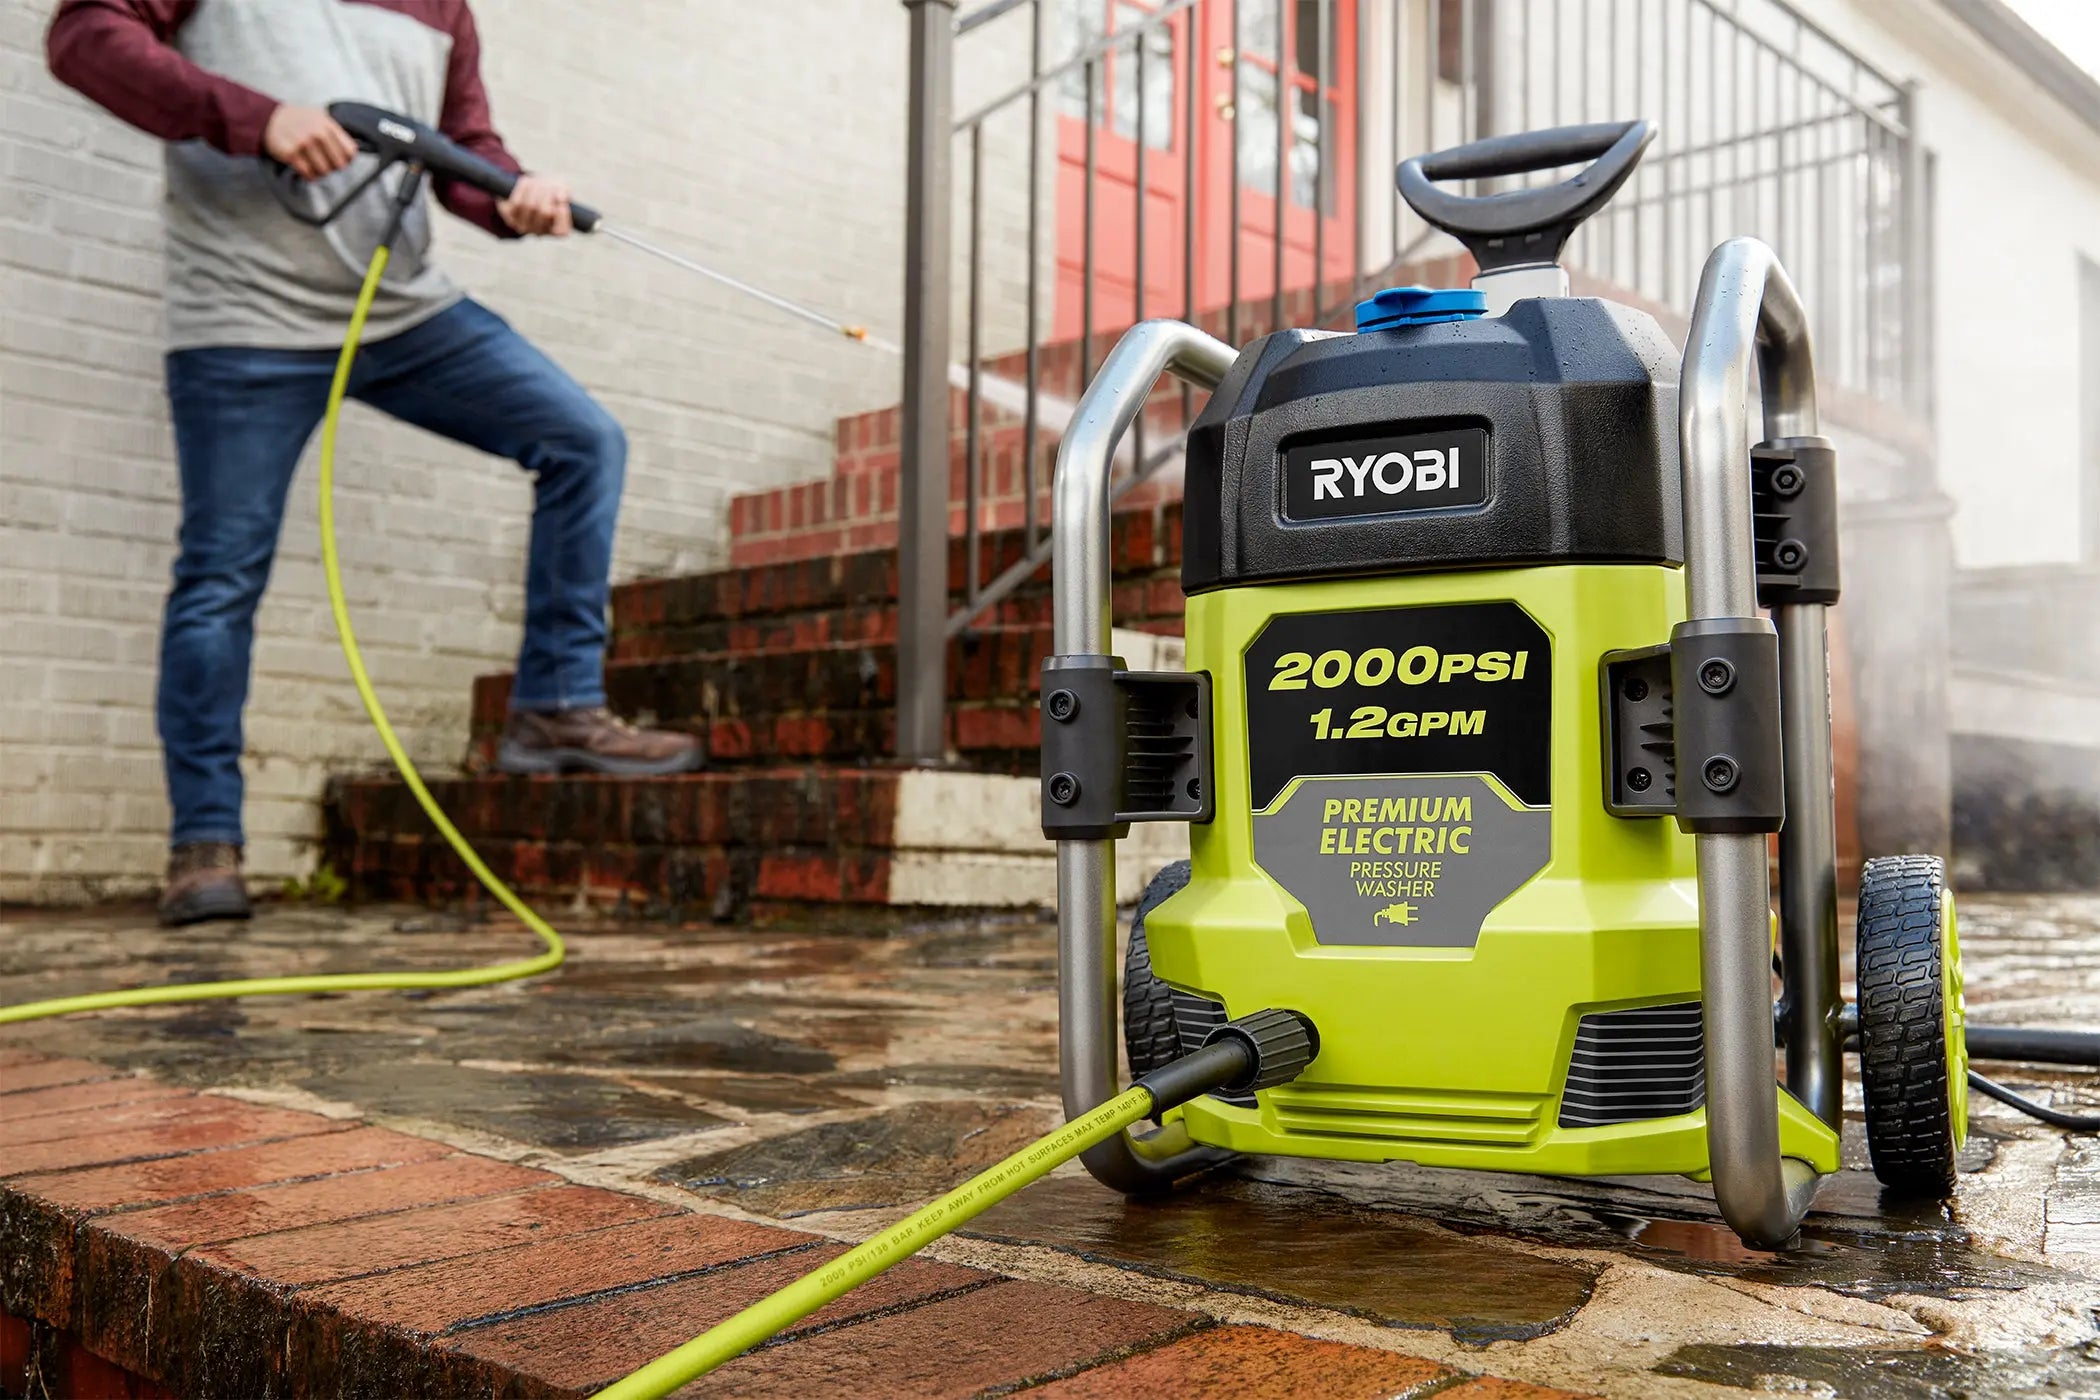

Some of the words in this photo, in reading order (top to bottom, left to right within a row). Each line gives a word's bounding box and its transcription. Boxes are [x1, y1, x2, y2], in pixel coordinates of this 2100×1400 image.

[1310, 446, 1460, 501] RYOBI
[1322, 796, 1473, 824] PREMIUM
[1319, 826, 1473, 855] ELECTRIC
[1350, 861, 1442, 878] PRESSURE
[1355, 880, 1435, 897] WASHER
[820, 1268, 846, 1287] 2000
[848, 1243, 888, 1270] PSI/138
[891, 1227, 914, 1245] BAR
[917, 1209, 944, 1232] KEEP
[948, 1190, 974, 1213] AWAY
[977, 1173, 1006, 1194] FROM
[1006, 1161, 1026, 1177] HOT
[1028, 1133, 1074, 1164] SURFACES
[1074, 1121, 1094, 1138] MAX
[1094, 1108, 1116, 1126] TEMP
